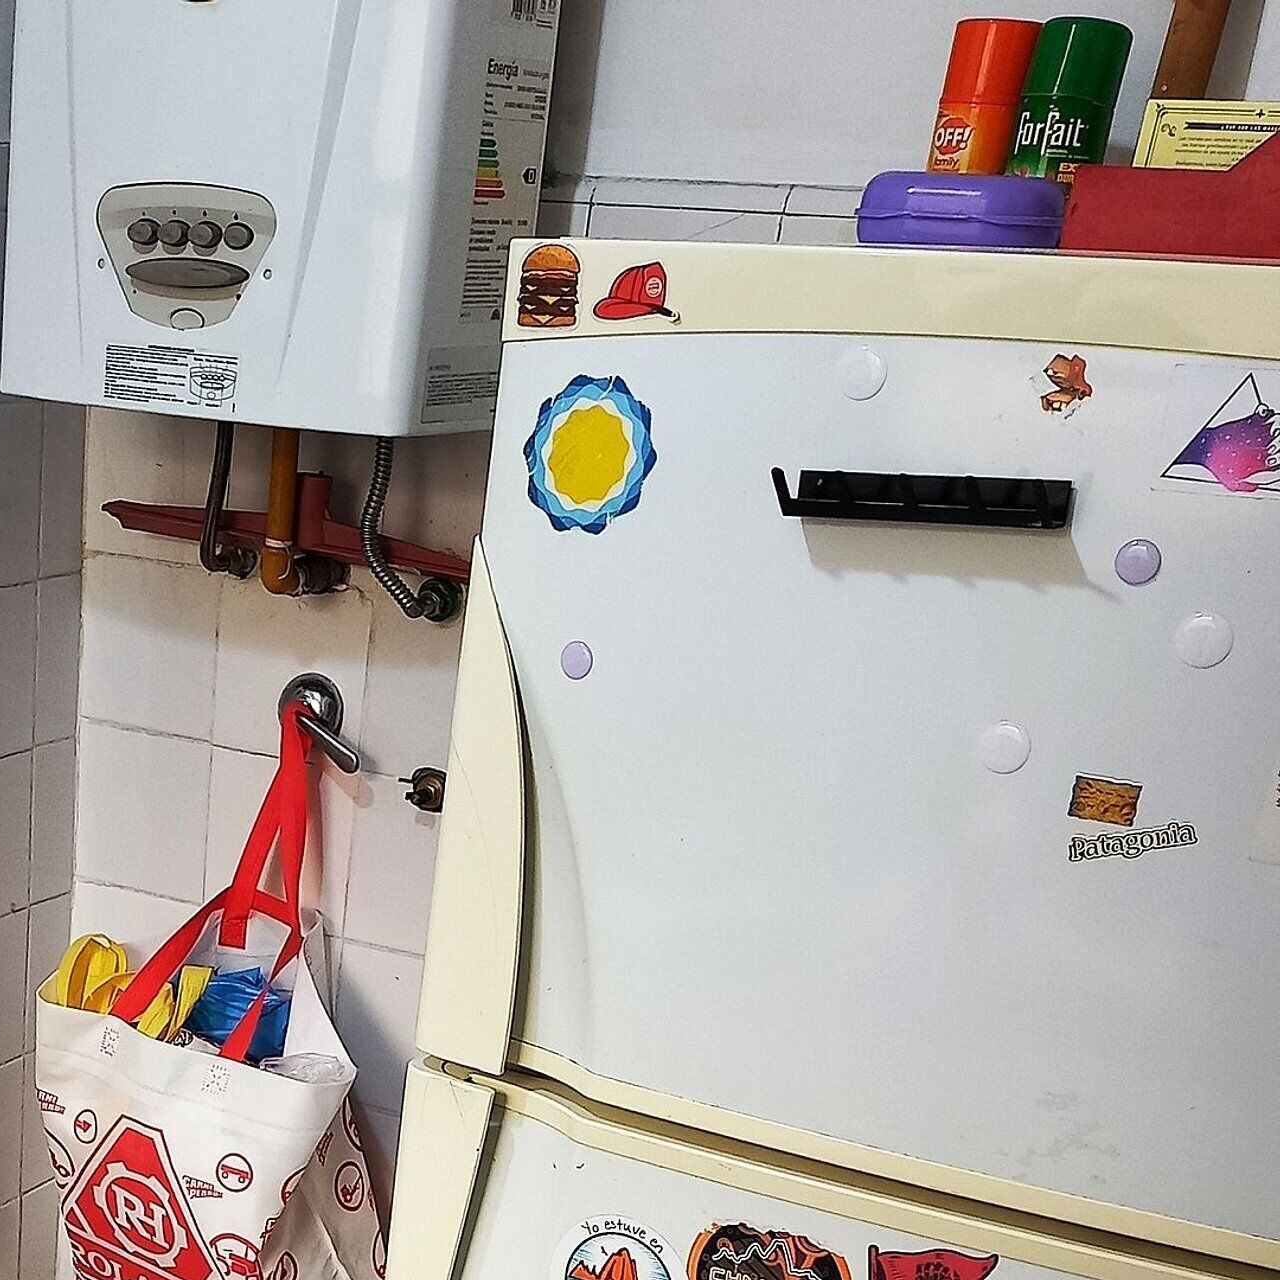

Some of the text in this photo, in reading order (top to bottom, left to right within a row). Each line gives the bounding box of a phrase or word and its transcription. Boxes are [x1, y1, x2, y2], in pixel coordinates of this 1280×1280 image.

[935, 127, 973, 149] OFF!
[1070, 823, 1198, 862] Patagonia
[581, 1219, 664, 1254] Yo estuve en
